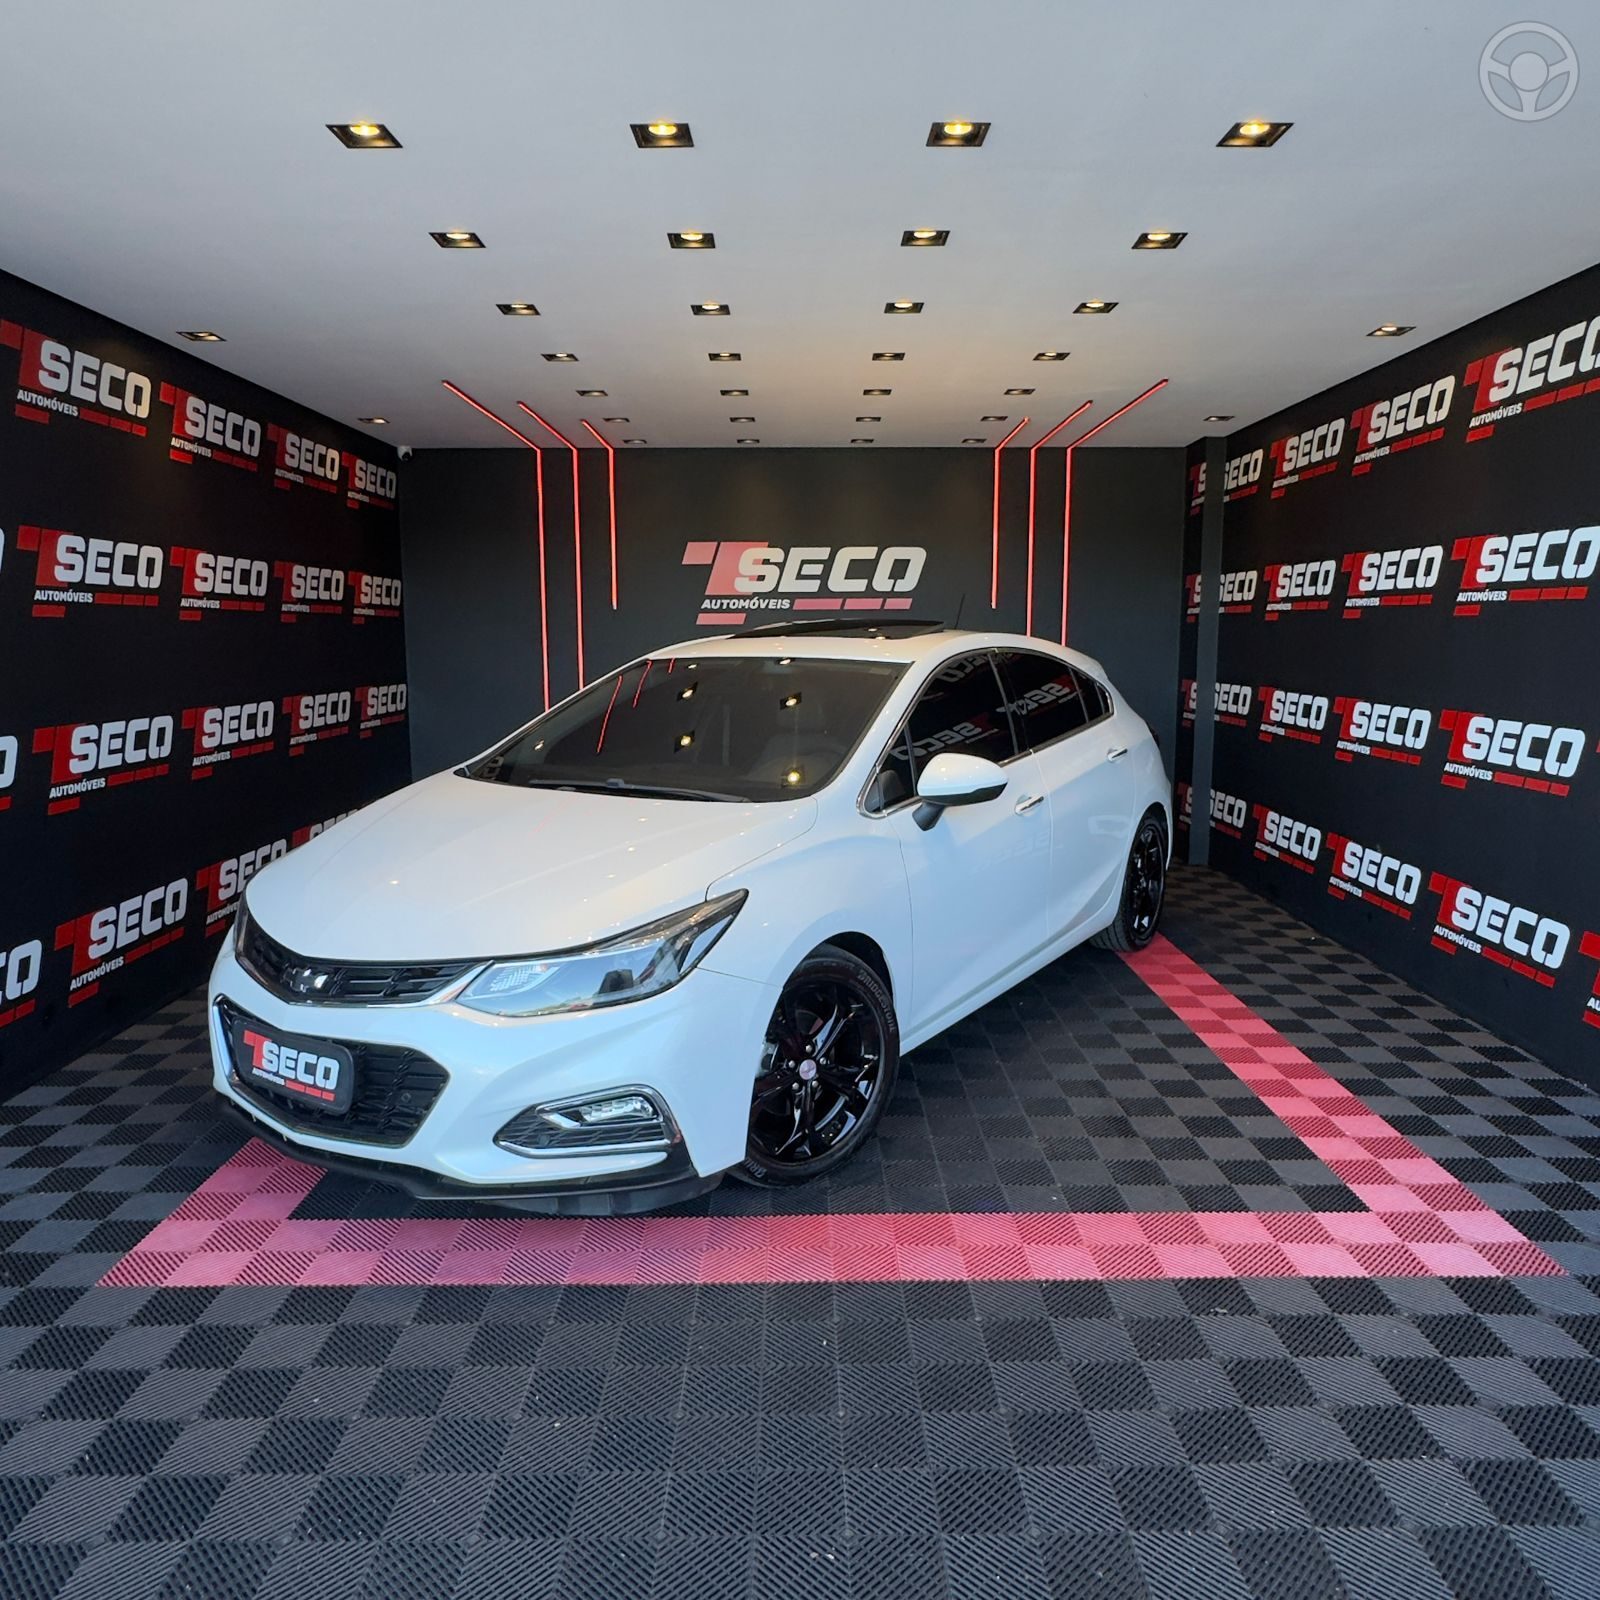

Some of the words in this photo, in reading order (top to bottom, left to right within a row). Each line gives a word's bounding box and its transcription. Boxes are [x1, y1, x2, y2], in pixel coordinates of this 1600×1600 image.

[17, 389, 78, 417] AUTOMÓVEIS
[1469, 403, 1522, 428] AUTOMÓVEIS
[34, 589, 93, 603] AUTOMÓVEIS
[701, 596, 790, 610] AUTOMÓVEIS
[1456, 589, 1508, 602] AUTOMÓVEIS
[1443, 762, 1493, 781] AUTOMÓVEIS
[49, 778, 106, 799] AUTOMÓVEIS
[1433, 924, 1482, 954] AUTOMÓVEIS
[70, 956, 124, 991] AUTOMÓVEIS
